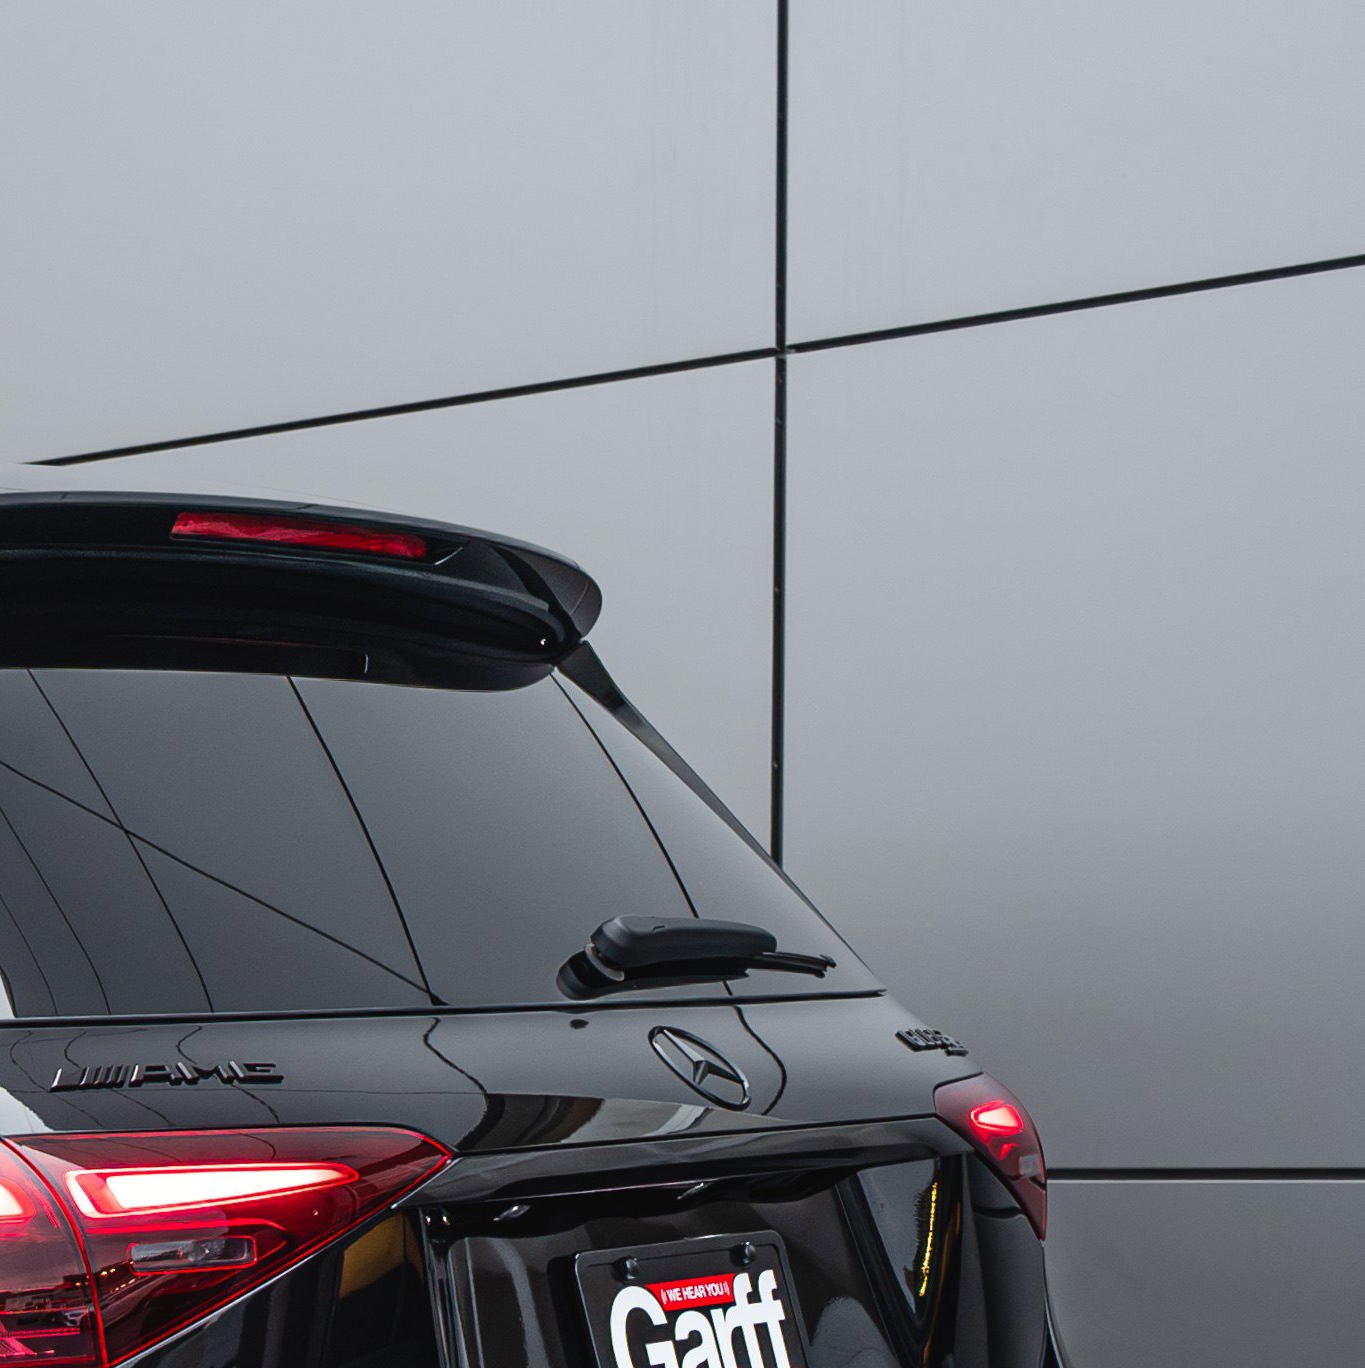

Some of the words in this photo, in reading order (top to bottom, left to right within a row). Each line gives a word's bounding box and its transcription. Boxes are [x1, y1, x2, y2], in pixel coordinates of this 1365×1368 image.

[666, 1287, 683, 1303] WE
[681, 1284, 707, 1301] HEAR
[704, 1281, 724, 1297] YOU
